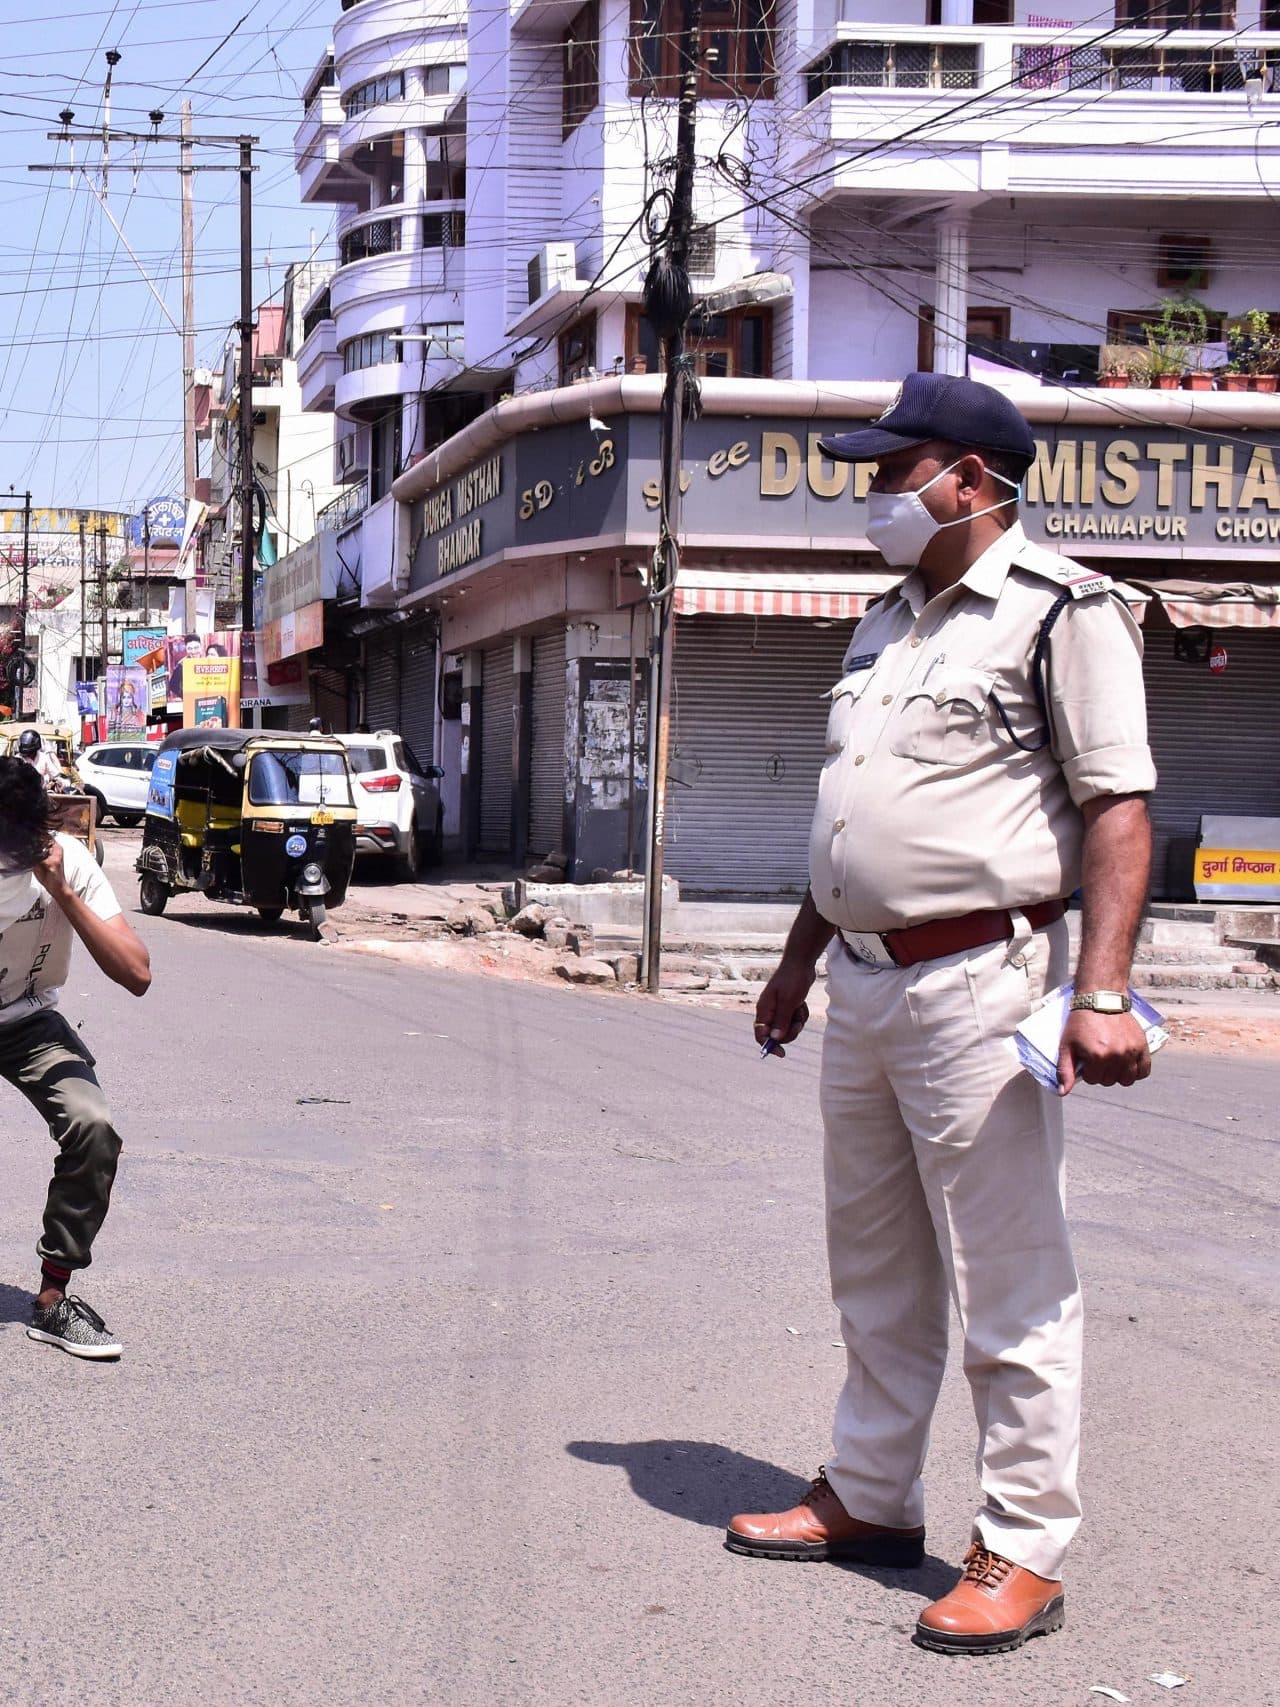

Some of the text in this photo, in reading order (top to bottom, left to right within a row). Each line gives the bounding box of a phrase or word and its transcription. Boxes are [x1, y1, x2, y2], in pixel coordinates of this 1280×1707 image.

[423, 455, 501, 538] DURGA MISTHAN
[1046, 511, 1187, 536] GHAMAPUR
[438, 518, 481, 576] BHANDAR
[1202, 856, 1230, 878] दुर्गा
